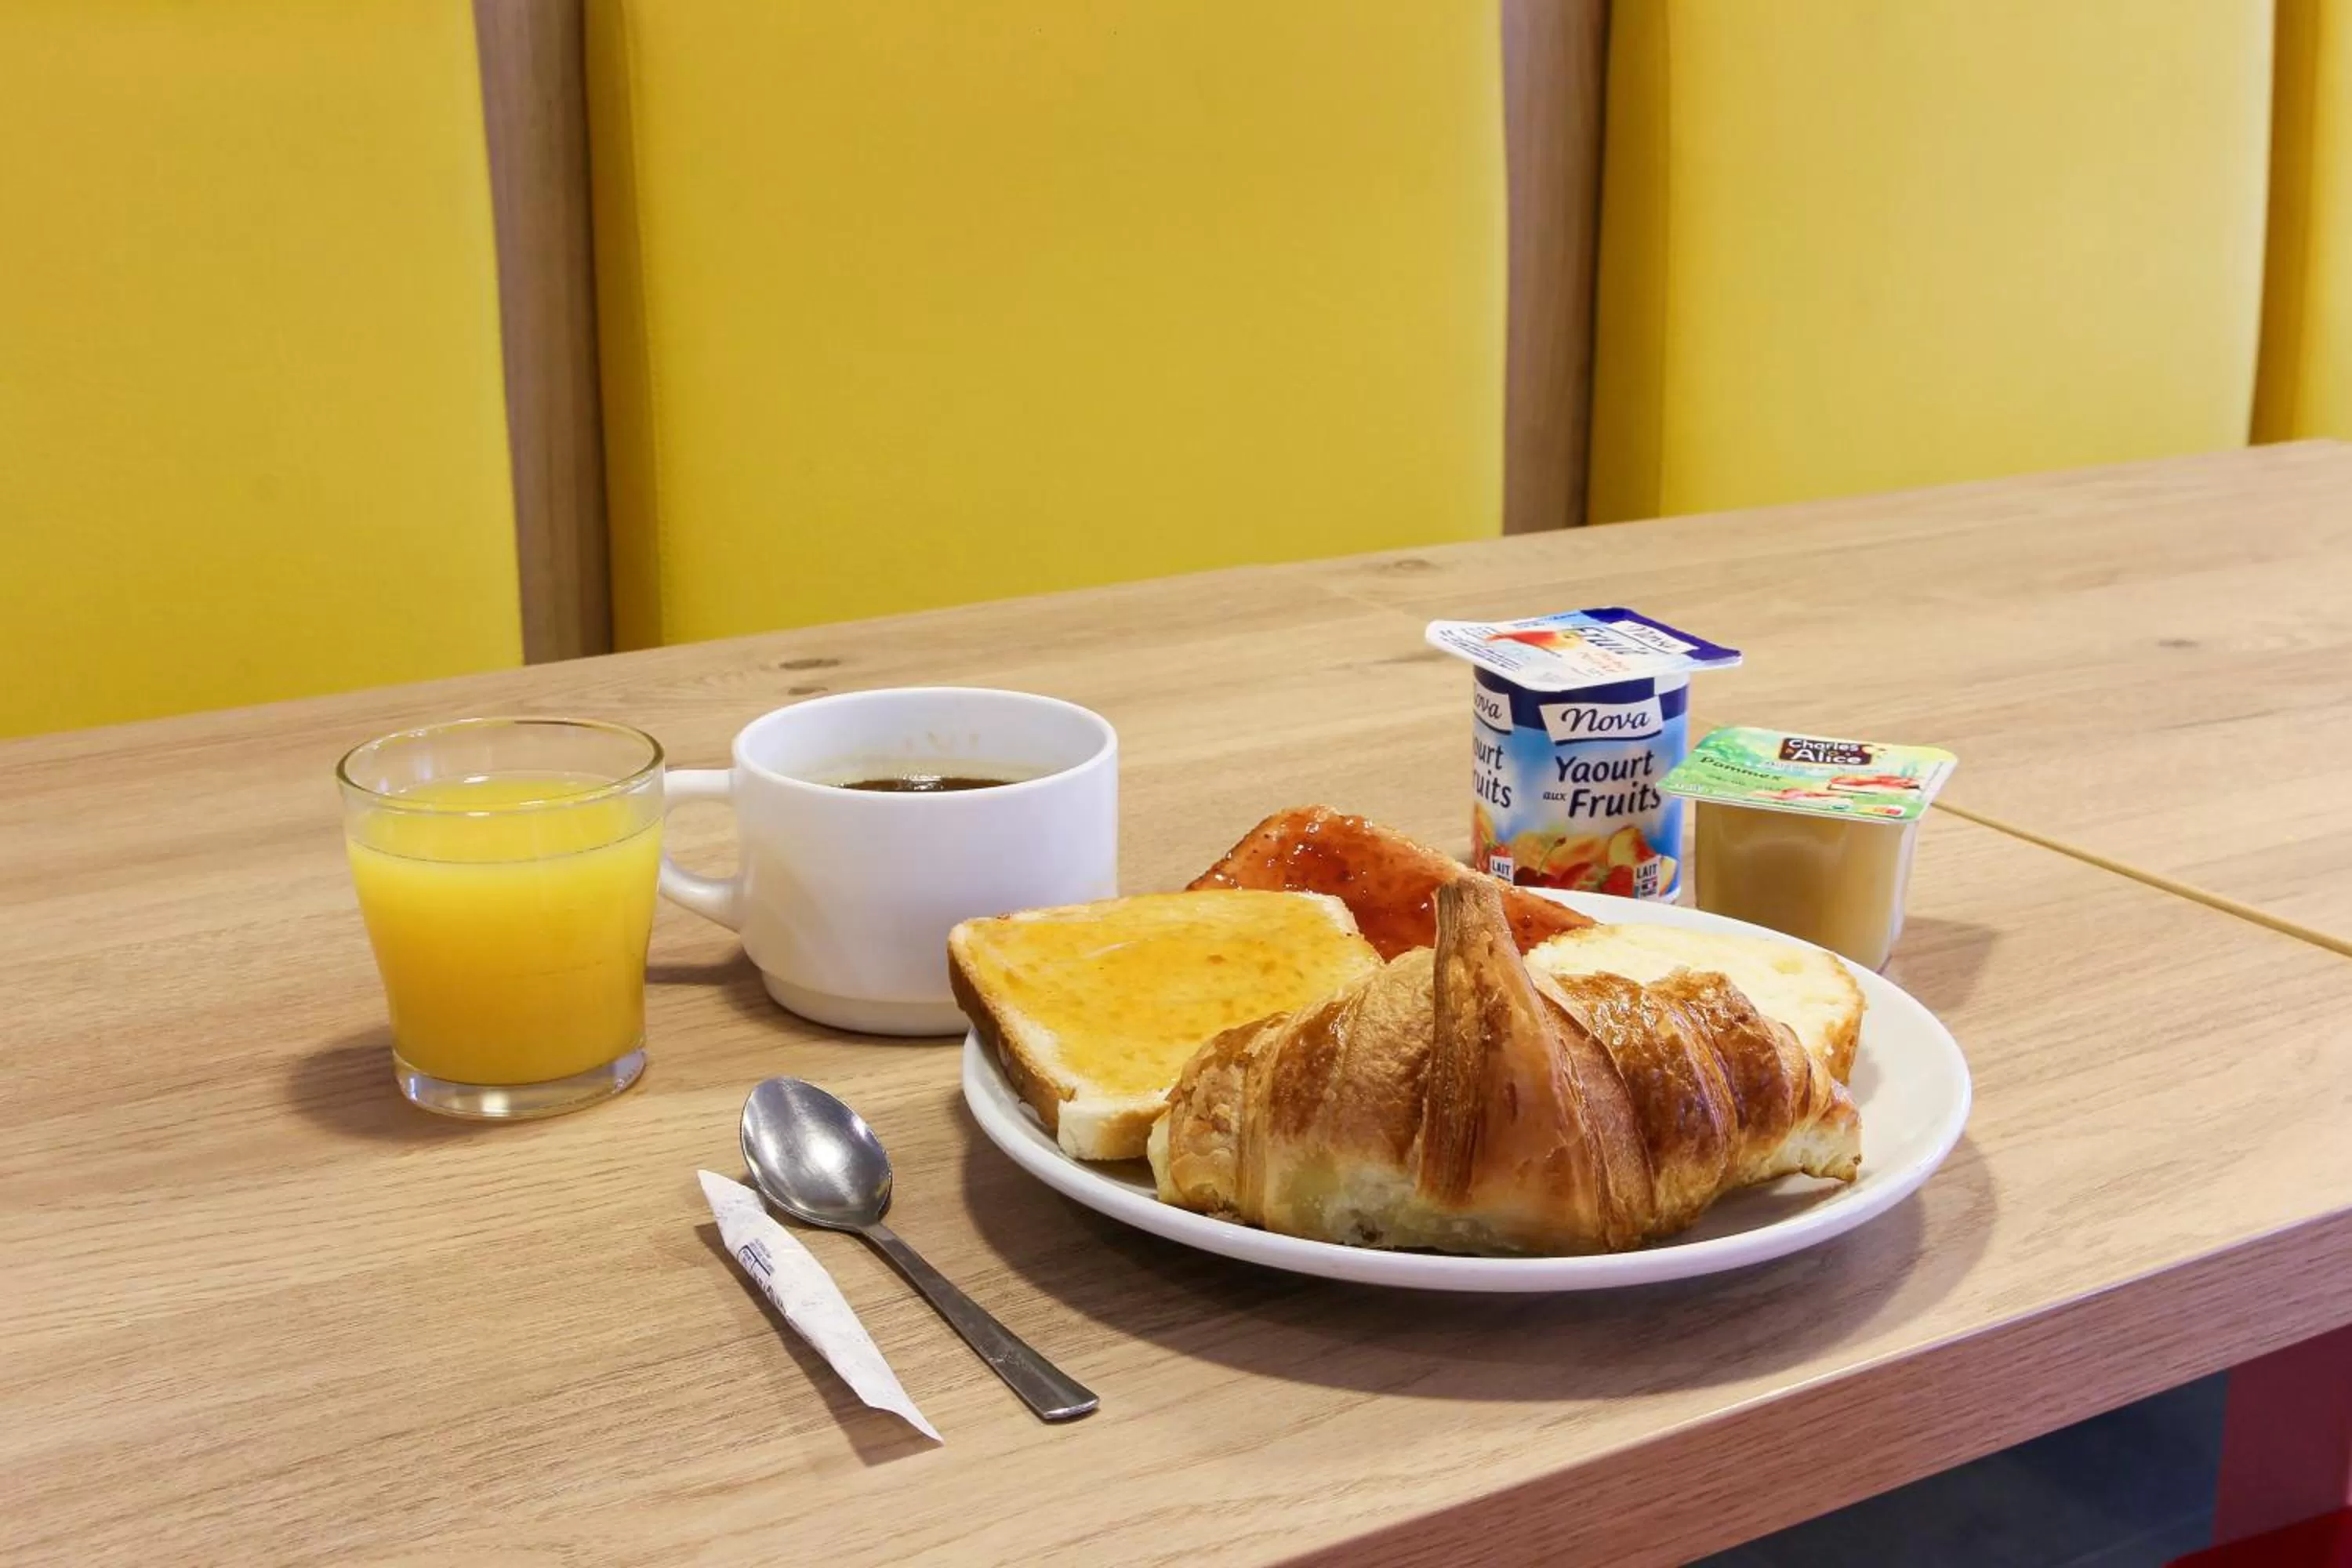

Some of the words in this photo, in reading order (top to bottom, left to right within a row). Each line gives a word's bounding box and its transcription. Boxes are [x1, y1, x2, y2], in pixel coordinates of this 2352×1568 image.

[1475, 693, 1503, 719] ova
[1561, 707, 1650, 732] Nova
[1473, 737, 1504, 770] ourt
[1788, 739, 1860, 752] Charles
[1791, 749, 1862, 764] Alice
[1555, 750, 1655, 783] Yaourt
[1473, 768, 1512, 808] ruits
[1542, 791, 1568, 802] aux
[1568, 782, 1662, 818] Fruits
[1492, 858, 1511, 877] LAIT
[1636, 863, 1658, 879] LAIT
